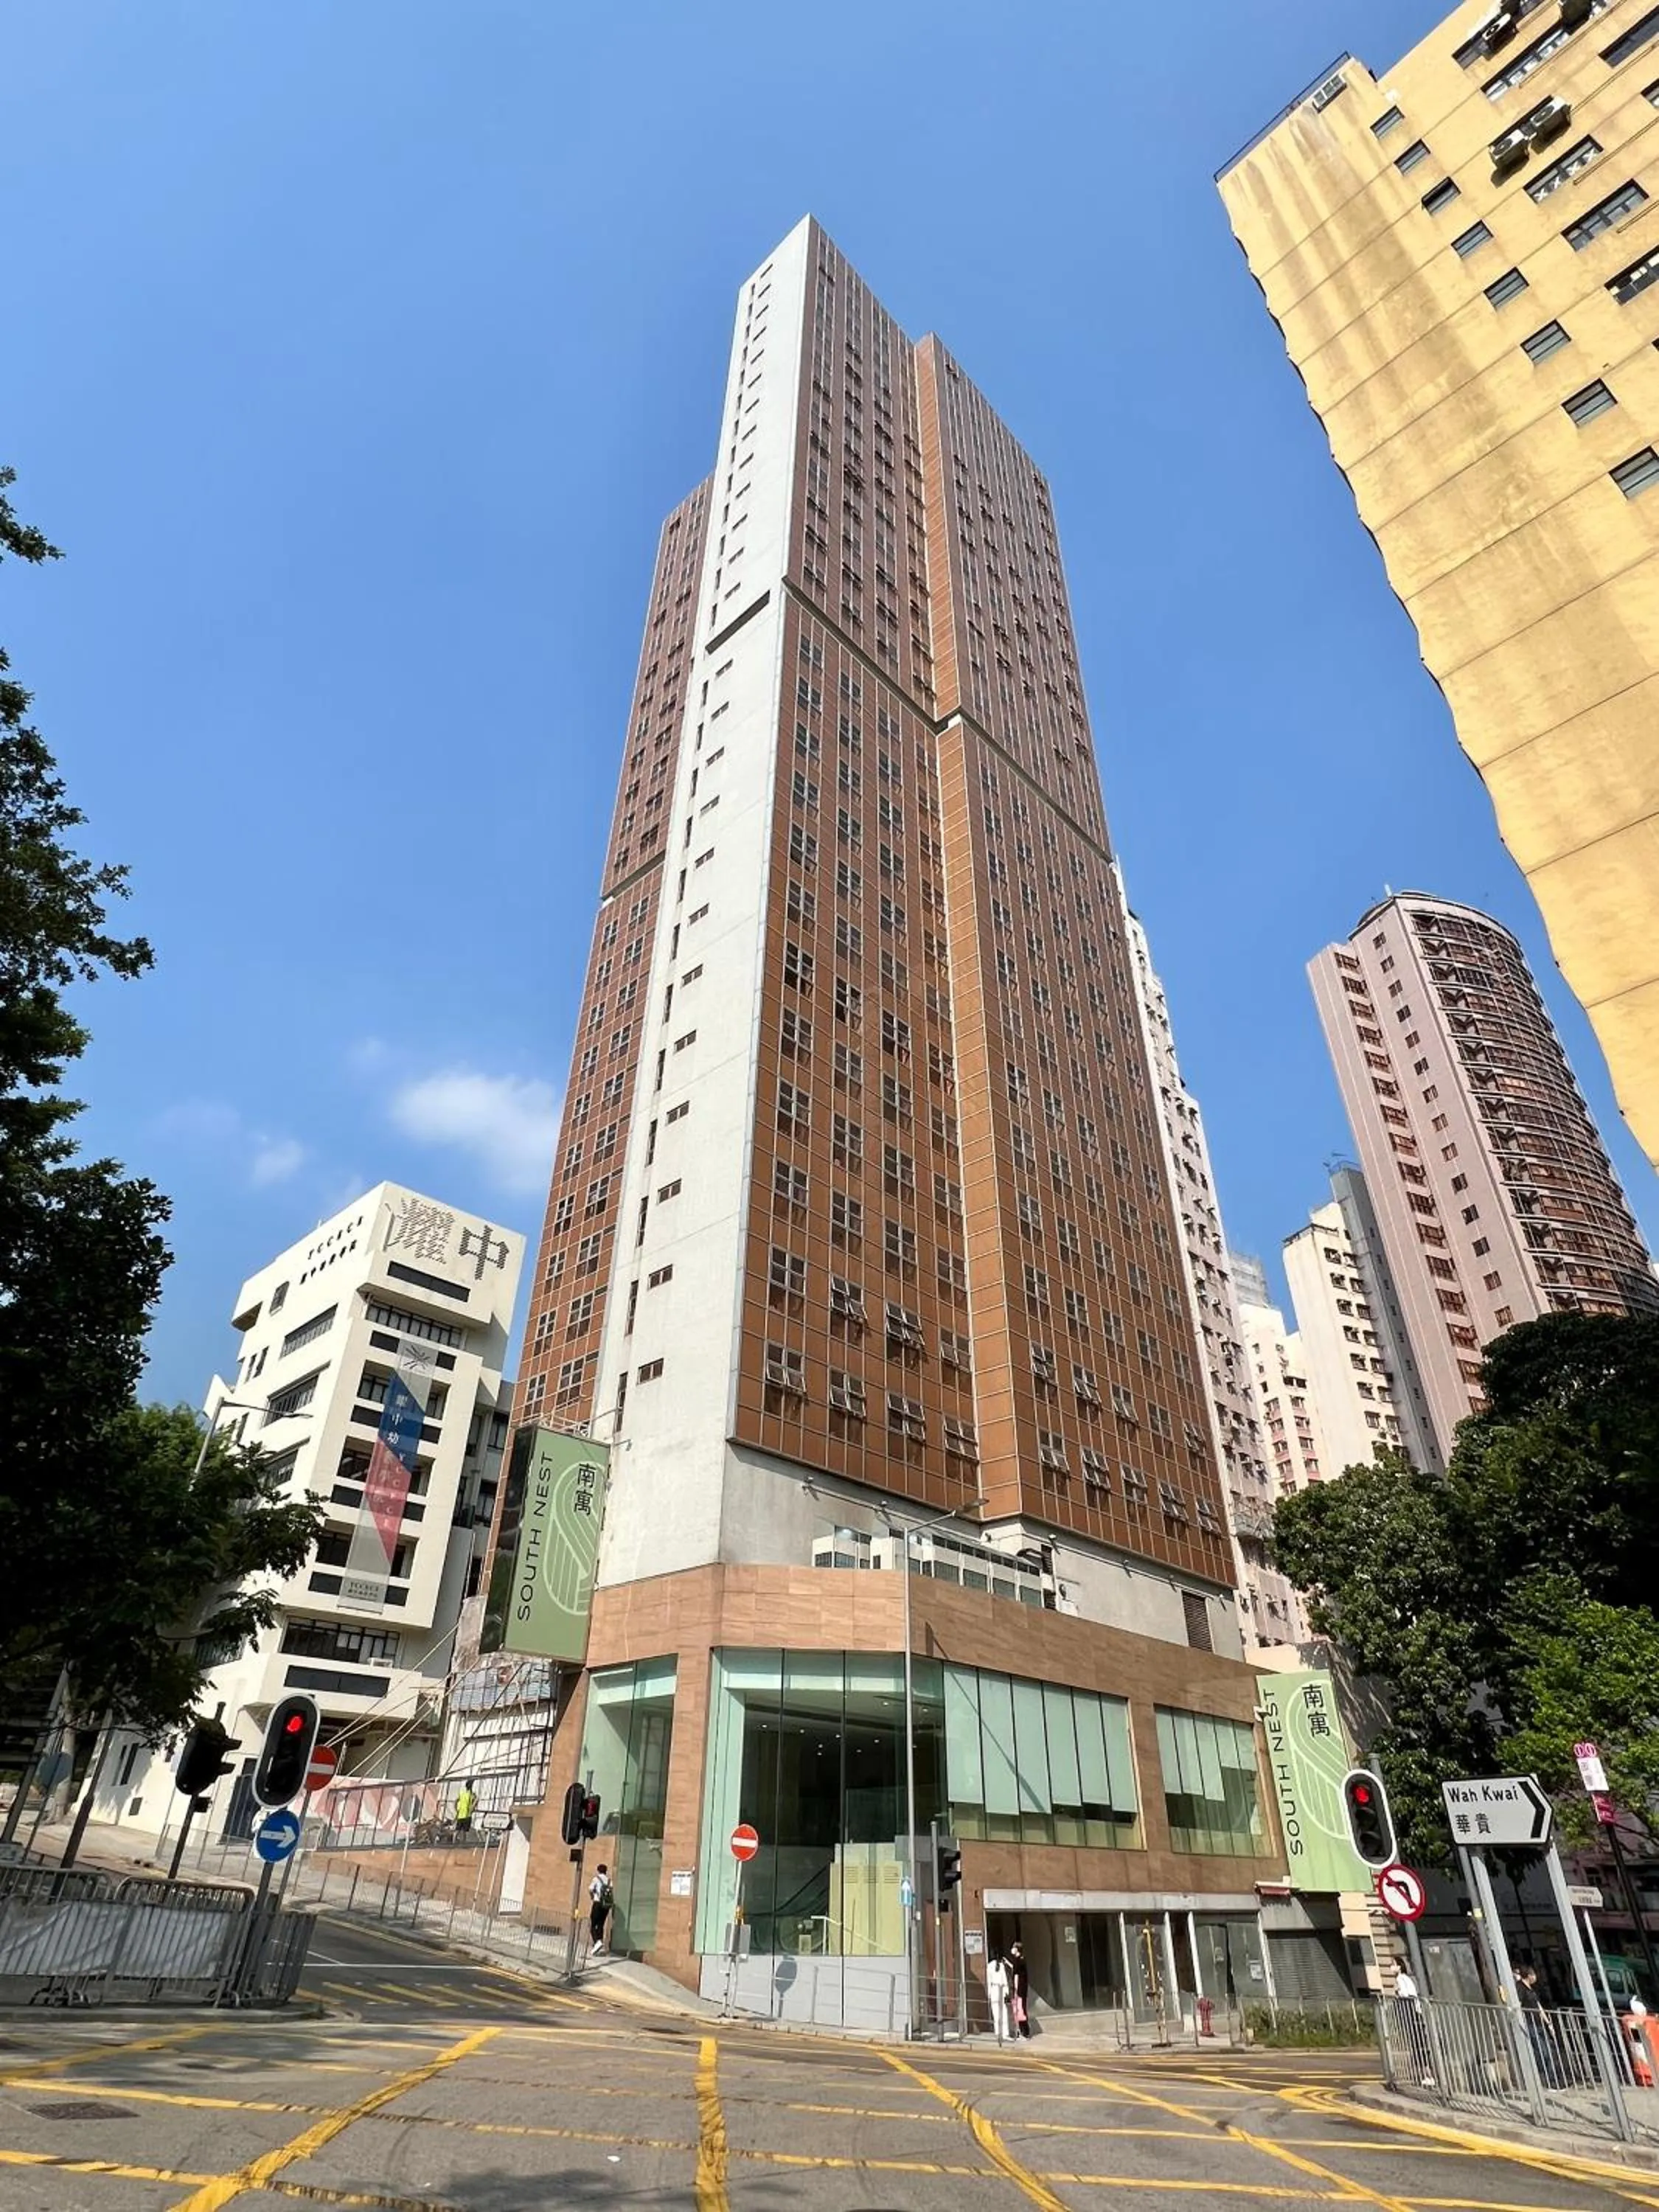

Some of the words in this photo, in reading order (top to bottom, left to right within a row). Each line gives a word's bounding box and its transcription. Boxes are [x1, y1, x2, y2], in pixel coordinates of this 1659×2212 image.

[573, 1462, 597, 1516] 南寓
[517, 1528, 542, 1622] SOUTH
[533, 1451, 553, 1517] NEST
[1262, 1688, 1285, 1753] NEST
[1301, 1683, 1330, 1738] 南寓
[1276, 1764, 1303, 1856] SOUTH
[1447, 1787, 1478, 1803] Wah
[1481, 1783, 1519, 1801] Kwai
[1455, 1813, 1492, 1834] 華貴
